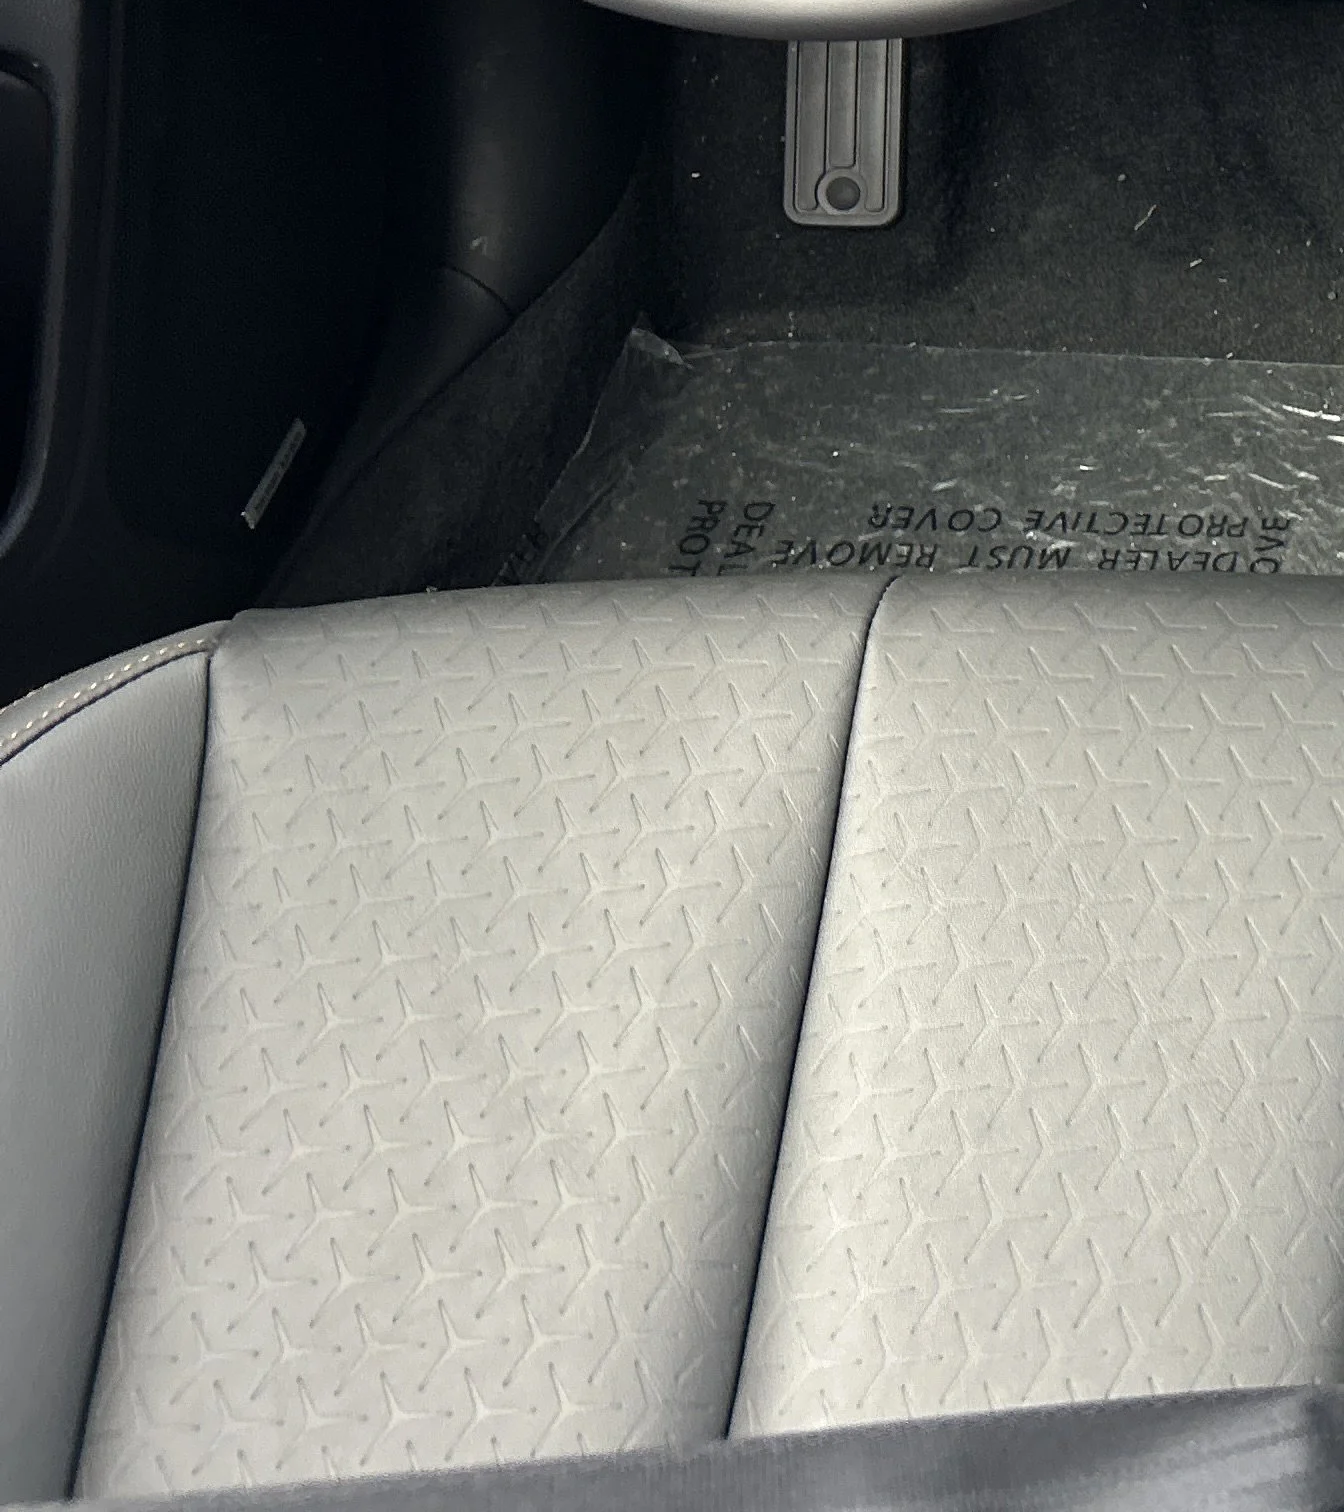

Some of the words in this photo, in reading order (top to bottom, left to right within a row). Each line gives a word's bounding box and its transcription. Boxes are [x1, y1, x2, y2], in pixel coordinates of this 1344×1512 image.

[867, 504, 1001, 533] COVER
[1023, 508, 1250, 539] PROTECTIVE
[774, 539, 941, 567] REMOVE
[966, 544, 1072, 570] MUST
[1097, 547, 1237, 573] DEALER
